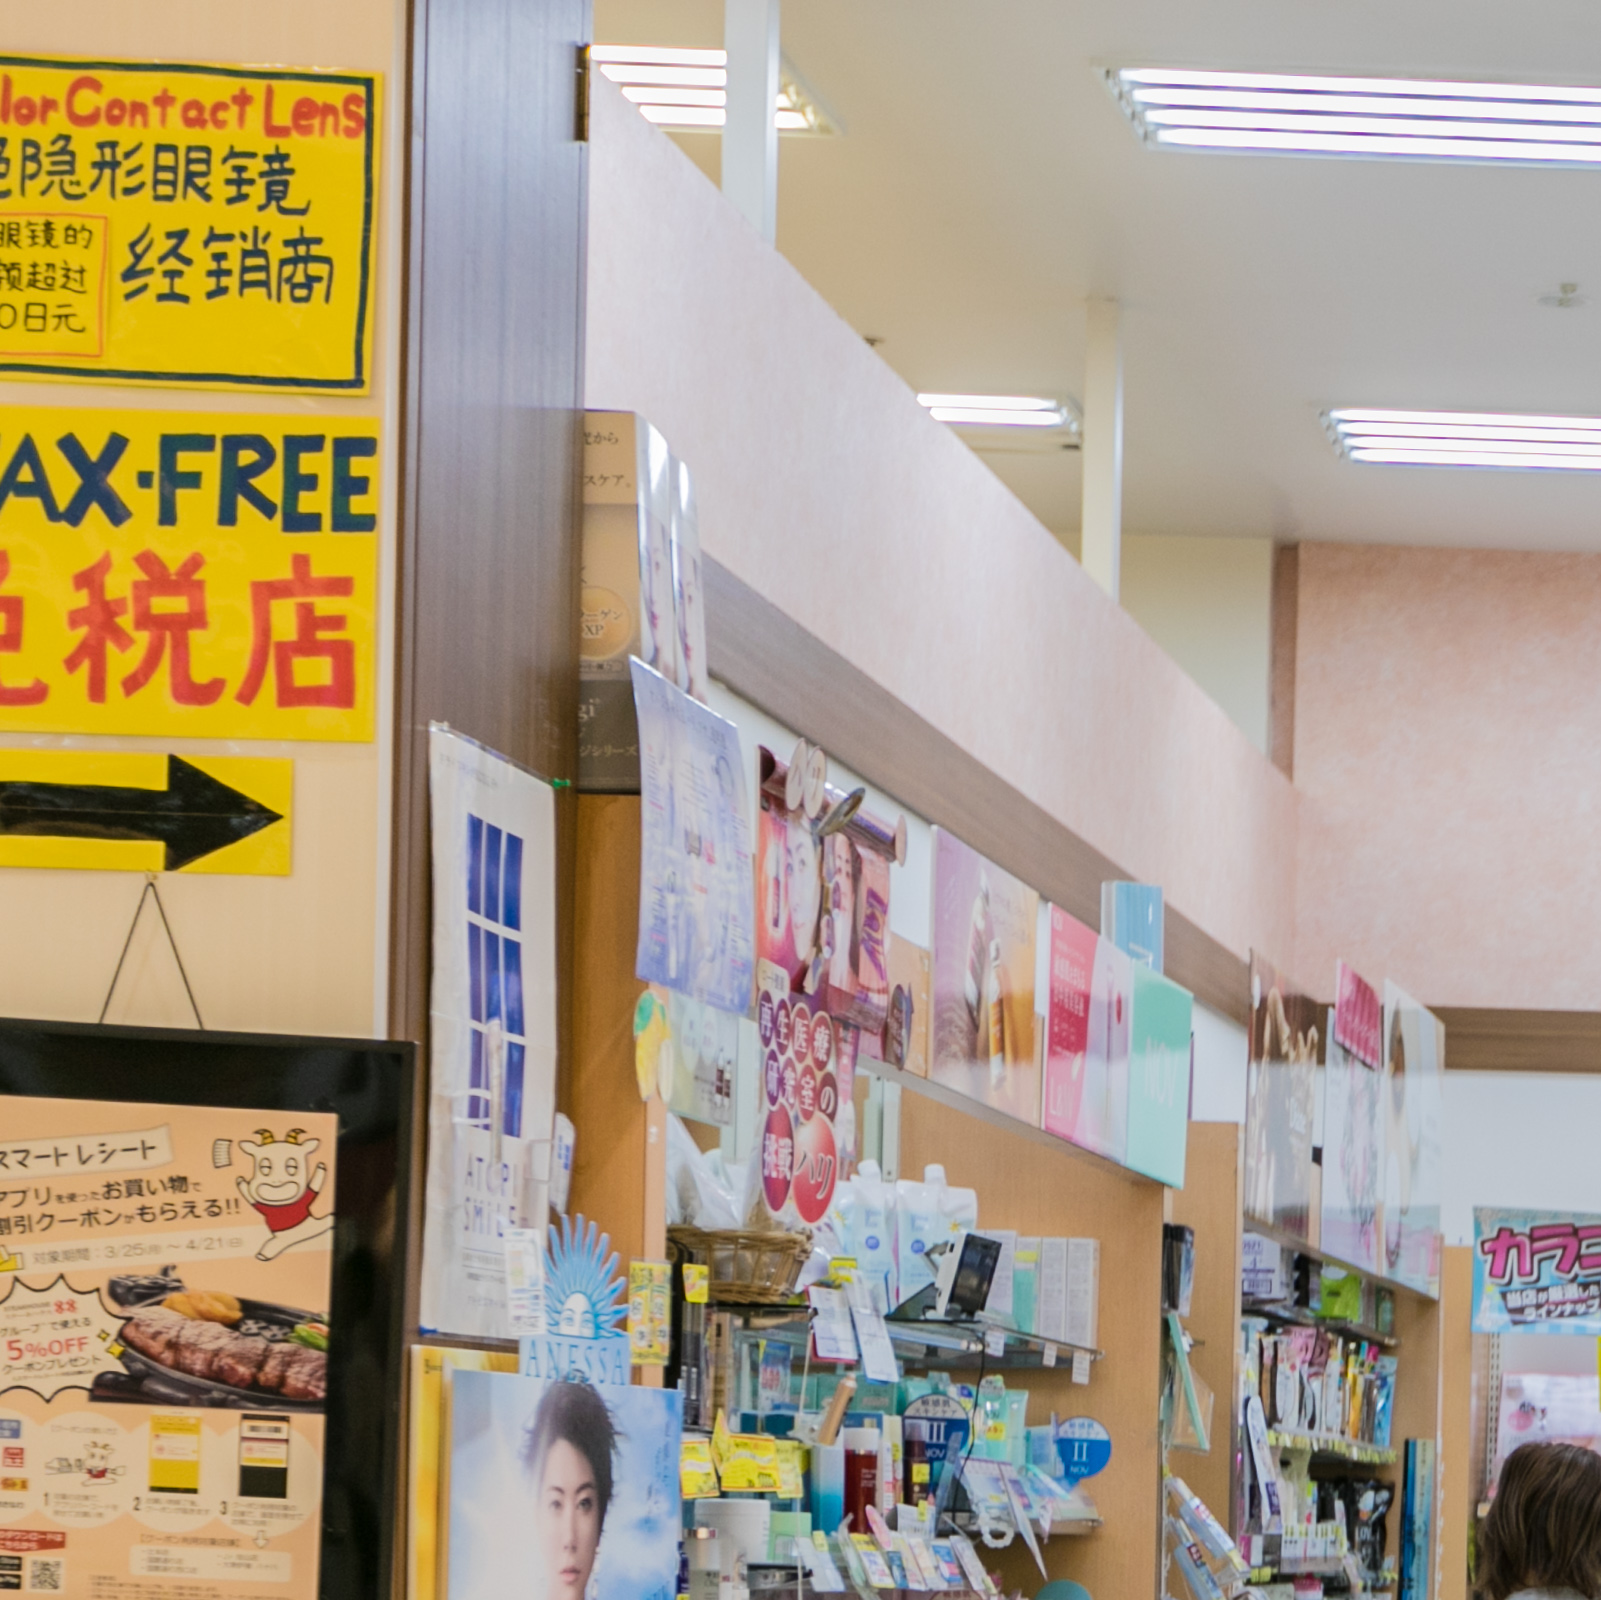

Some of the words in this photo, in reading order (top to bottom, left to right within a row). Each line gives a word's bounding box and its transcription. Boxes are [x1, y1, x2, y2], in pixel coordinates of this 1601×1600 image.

[65, 76, 254, 129] Contact
[263, 84, 366, 139] Lens
[121, 222, 334, 305] 经销商
[525, 1339, 627, 1386] ANESSA
